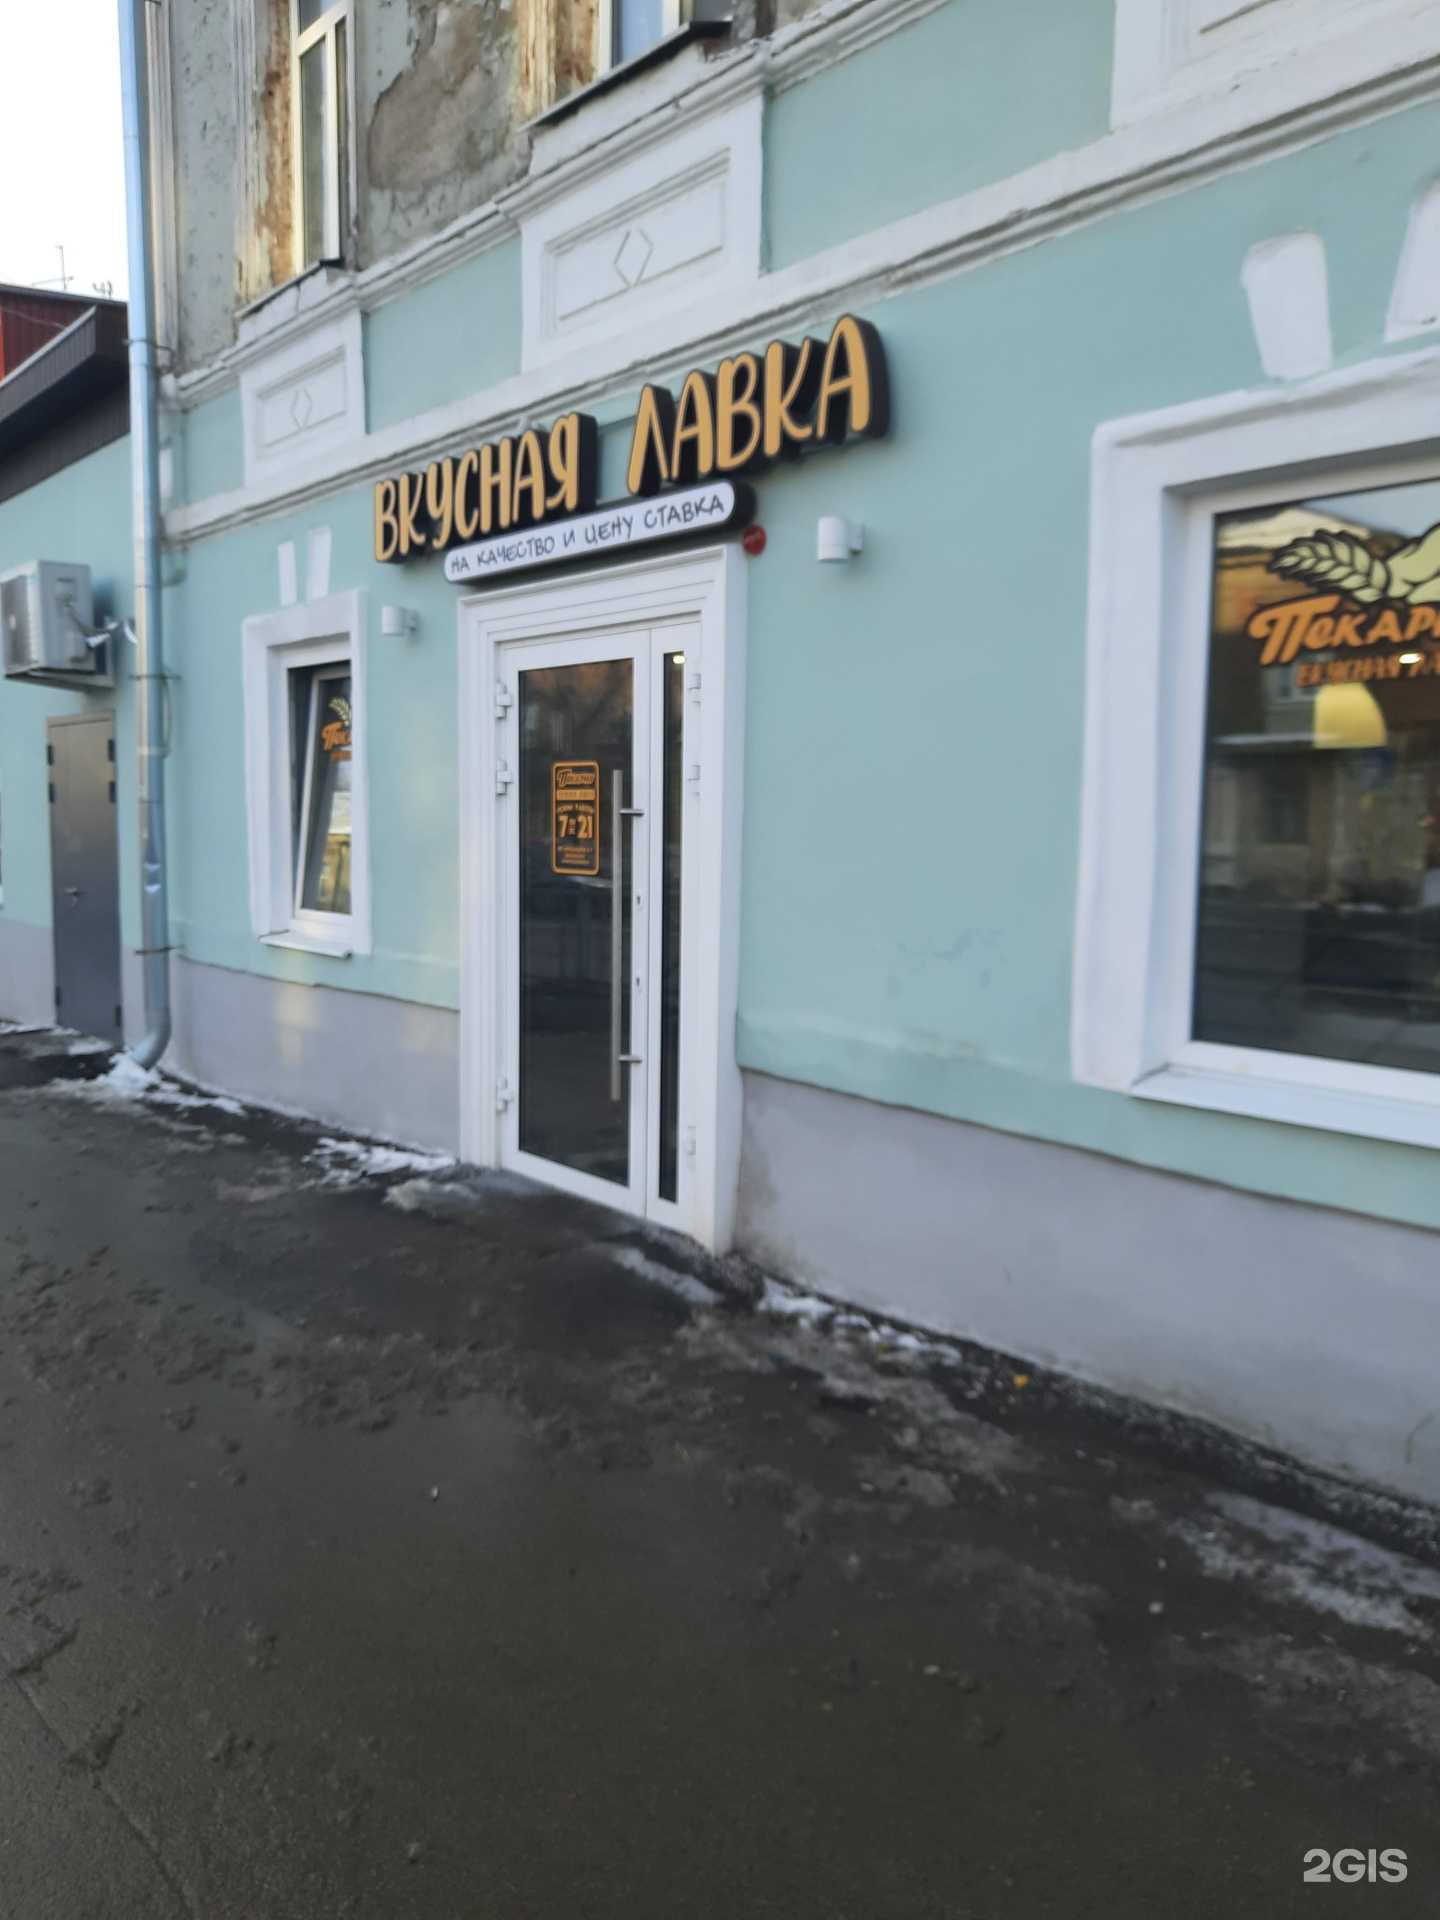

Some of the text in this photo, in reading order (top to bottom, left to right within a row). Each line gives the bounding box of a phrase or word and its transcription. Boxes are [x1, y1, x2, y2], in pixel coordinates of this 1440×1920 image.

[375, 313, 871, 562] ВКУСНАЯ ЛАВКА
[450, 495, 724, 574] НА КАЧЕСТВО И ЦЕНУ СТАВКА
